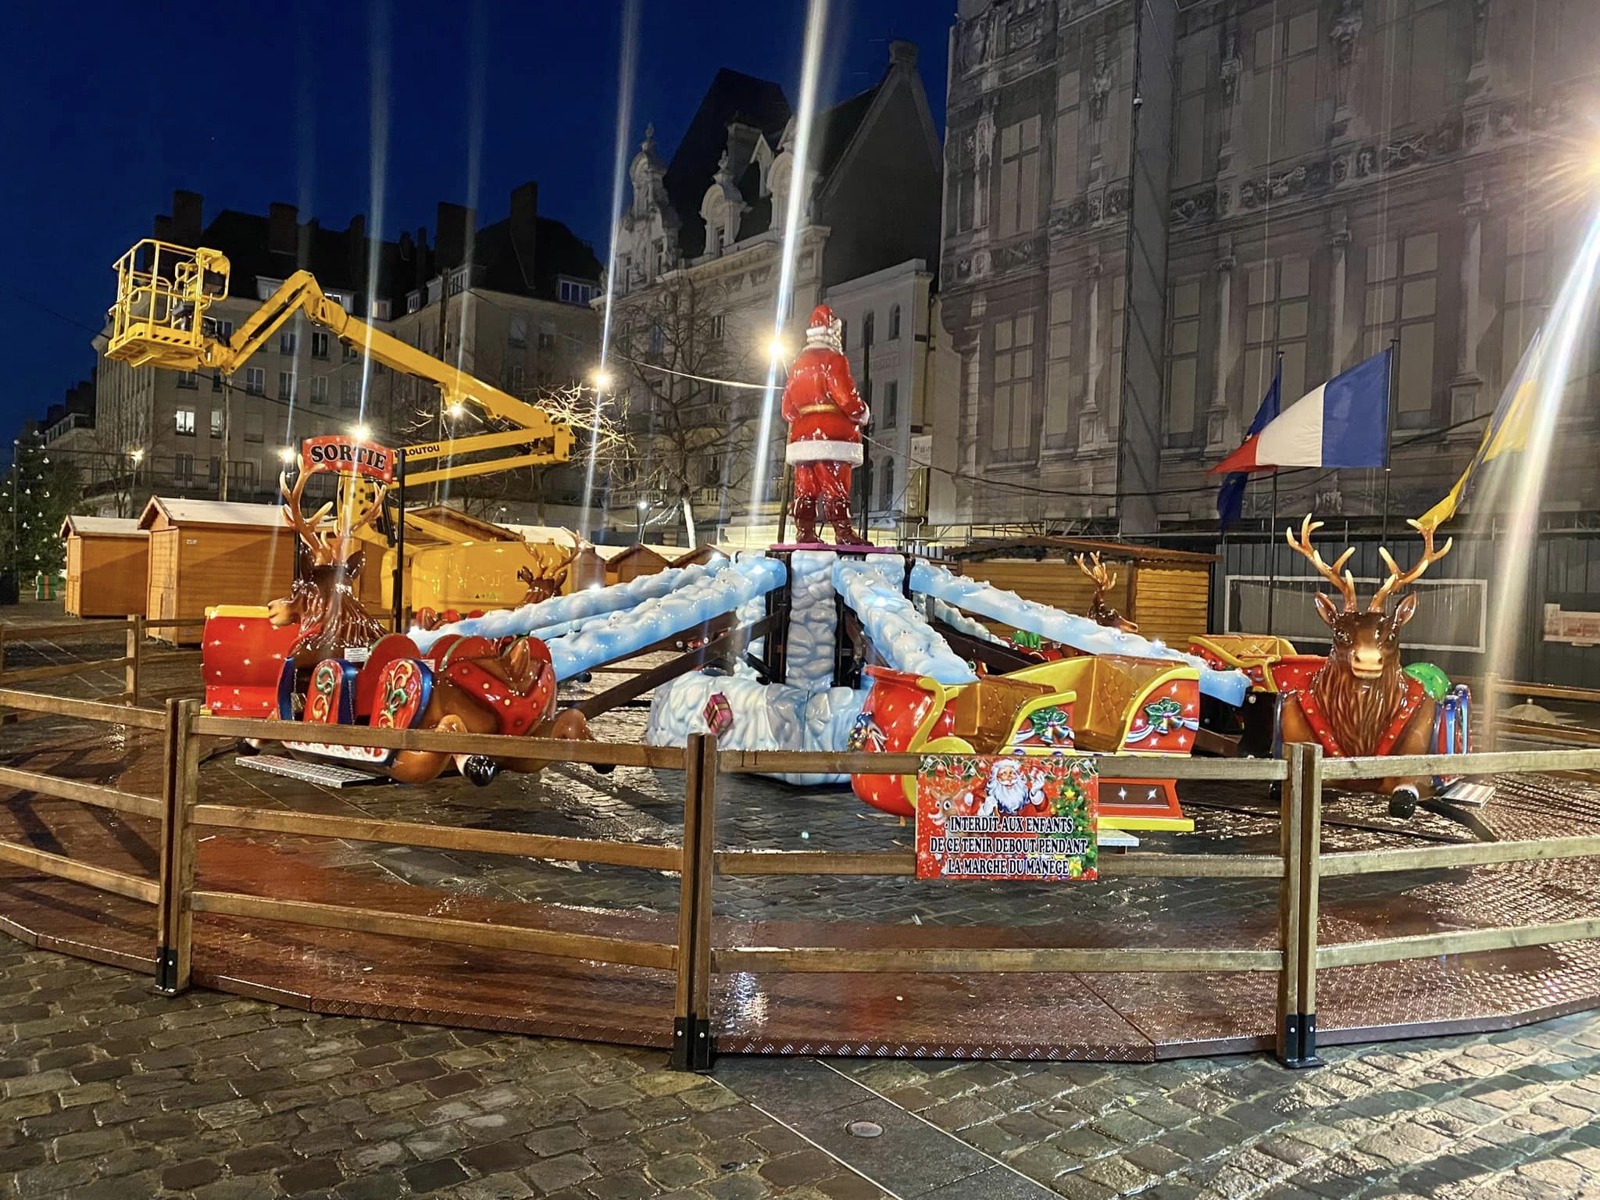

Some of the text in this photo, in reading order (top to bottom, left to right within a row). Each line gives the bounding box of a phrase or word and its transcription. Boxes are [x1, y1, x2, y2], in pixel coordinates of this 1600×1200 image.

[310, 444, 387, 471] SORTIE
[950, 816, 1074, 833] INTERDIT AUX ENFANTS
[930, 838, 1088, 853] DE CE TENIR DEBOUT PENDANT
[949, 859, 961, 874] LA
[962, 859, 1006, 874] MARCHE
[1008, 859, 1024, 875] DU
